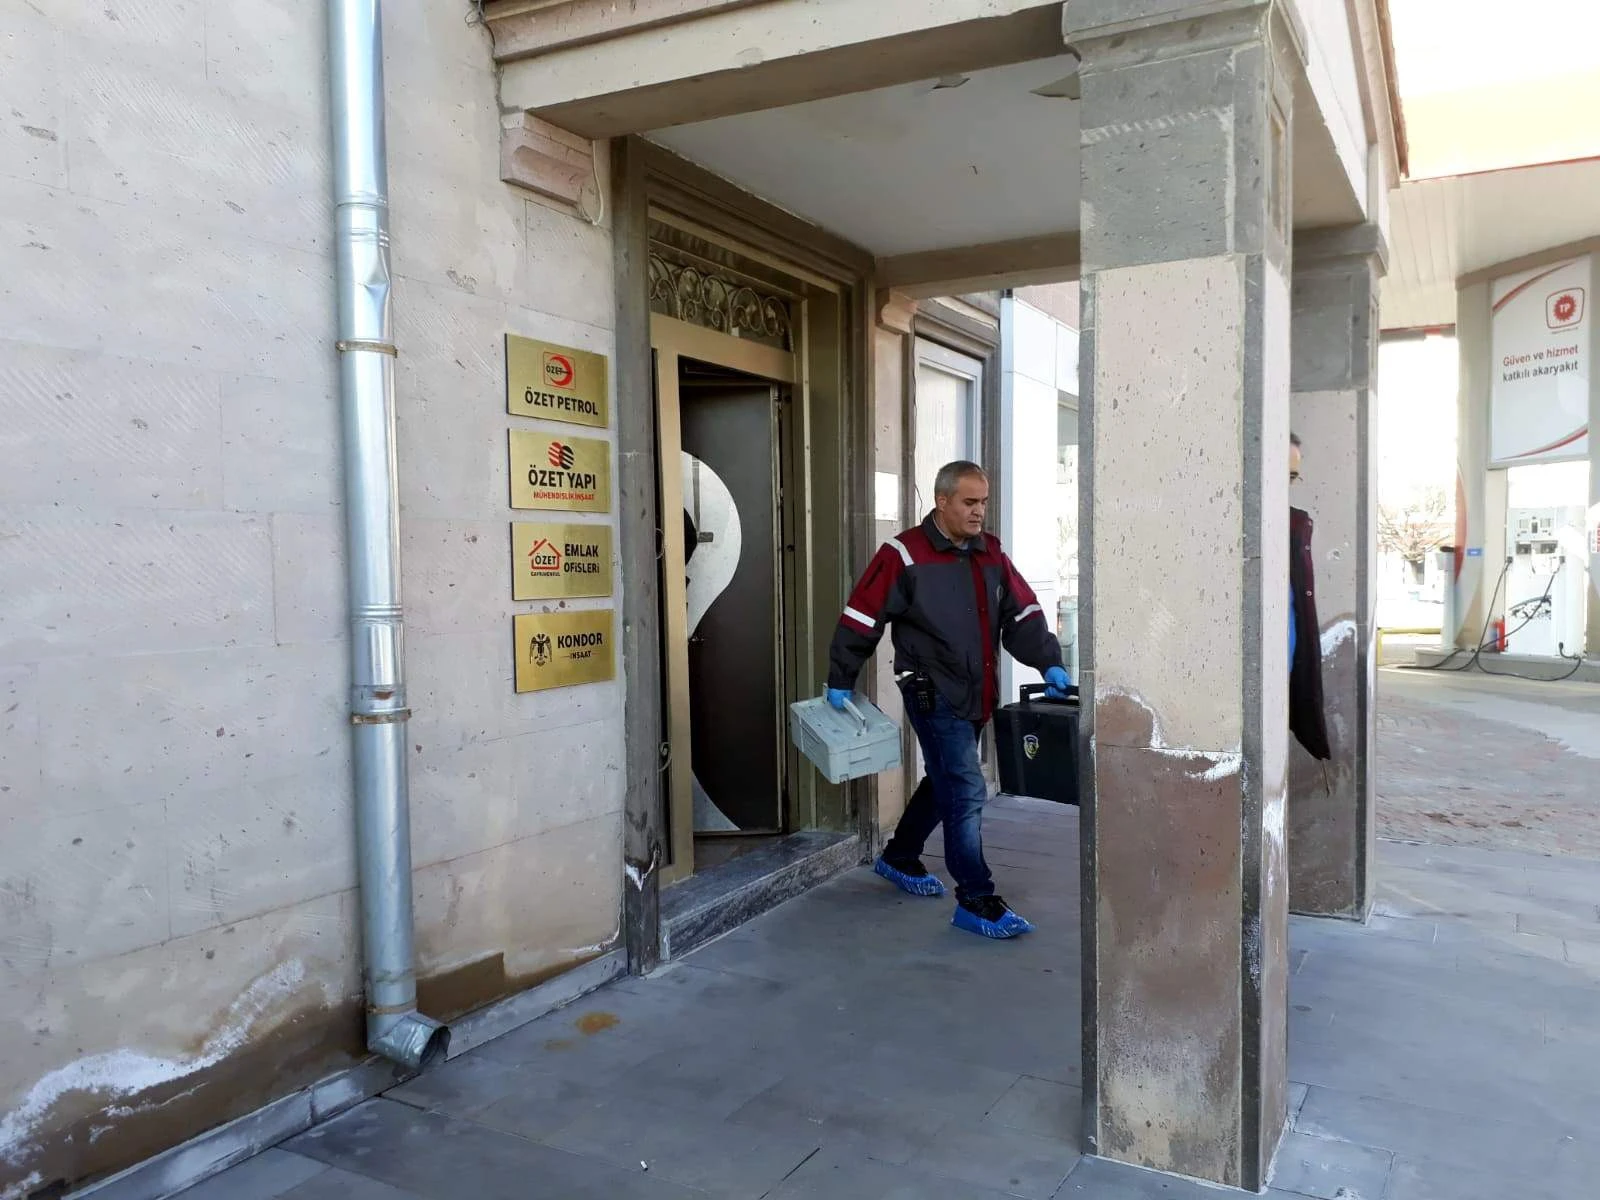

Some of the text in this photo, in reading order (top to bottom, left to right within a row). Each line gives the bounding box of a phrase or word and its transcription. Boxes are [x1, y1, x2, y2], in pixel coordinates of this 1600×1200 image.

[1559, 303, 1571, 314] TP
[1503, 344, 1578, 367] Güven ve hizmet
[1503, 361, 1578, 382] katkılı akaryakıt
[525, 386, 598, 415] ÖZET PETROL
[528, 464, 596, 490] ÖZET YAPI
[564, 543, 599, 557] EMLAK
[535, 553, 556, 566] ÖZET
[557, 633, 603, 649] KONDOR
